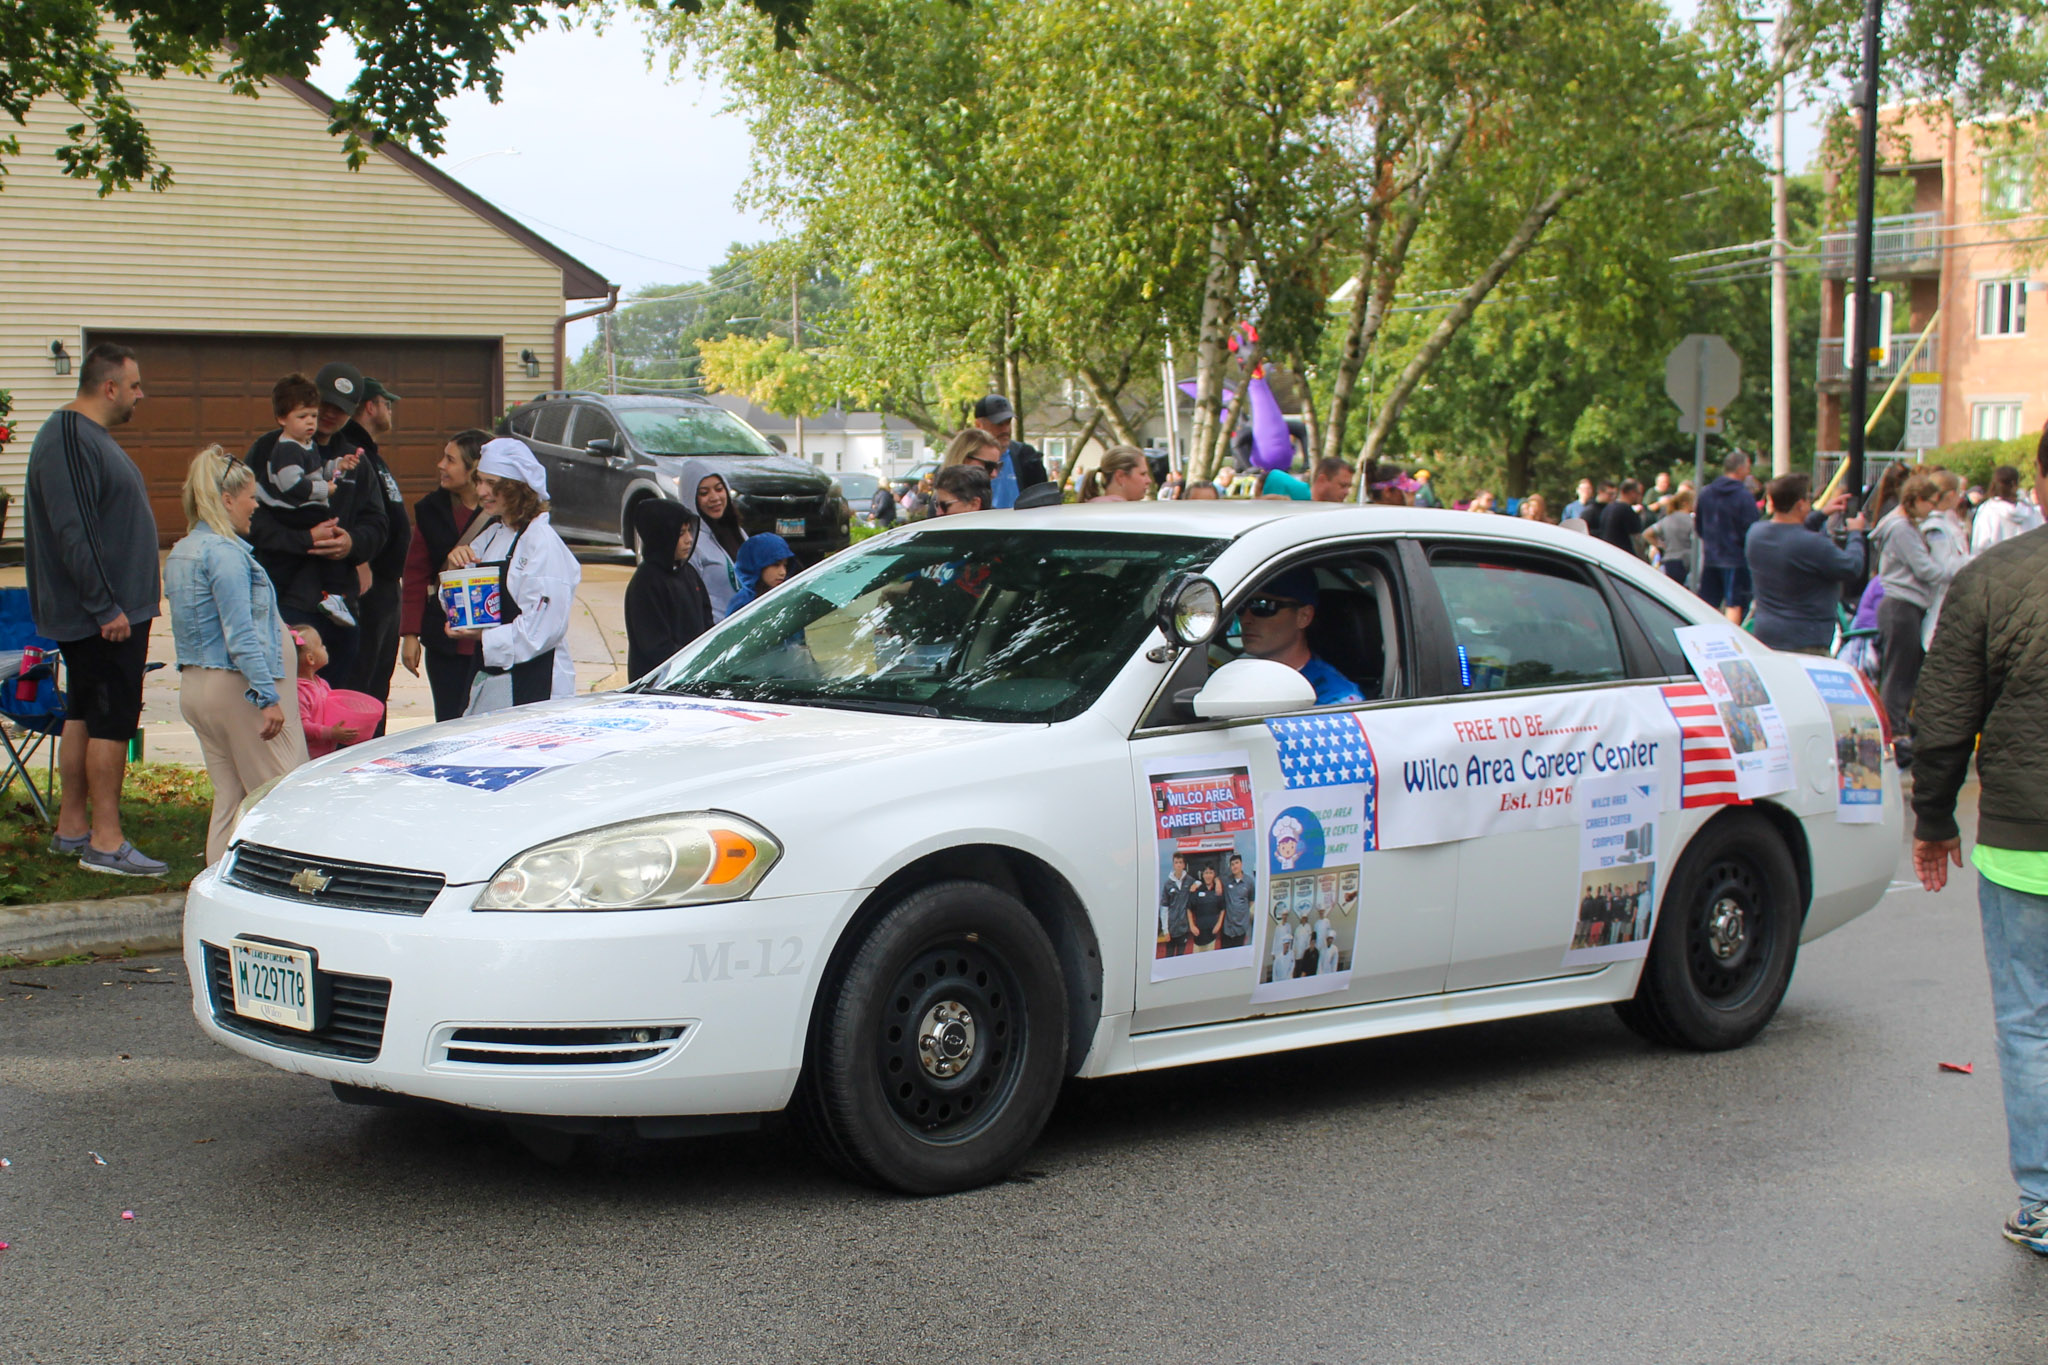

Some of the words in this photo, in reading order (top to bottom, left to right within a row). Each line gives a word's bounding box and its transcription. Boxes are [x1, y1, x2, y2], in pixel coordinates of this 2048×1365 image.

[1911, 408, 1937, 424] 20
[1453, 718, 1498, 743] FREE
[1498, 716, 1522, 739] TO
[1403, 757, 1459, 794] Wilco
[1466, 754, 1515, 787] Area
[1521, 748, 1586, 780] Career
[1592, 740, 1659, 772] Center
[1167, 791, 1204, 806] WILCO
[1205, 788, 1234, 802] AREA
[1499, 792, 1532, 812] Est.
[1535, 785, 1574, 807] 1976
[1592, 796, 1611, 808] WILCO
[1160, 812, 1203, 828] CAREER
[1204, 807, 1246, 824] CENTER
[1333, 806, 1352, 817] AREA
[1332, 824, 1359, 836] CENTER
[1586, 816, 1608, 830] CAREER
[1610, 813, 1632, 826] CENTER
[1592, 834, 1624, 848] COMPUTER
[1600, 856, 1616, 867] TECH
[682, 936, 805, 984] M-12
[239, 960, 249, 995] M
[252, 963, 305, 1007] 229778
